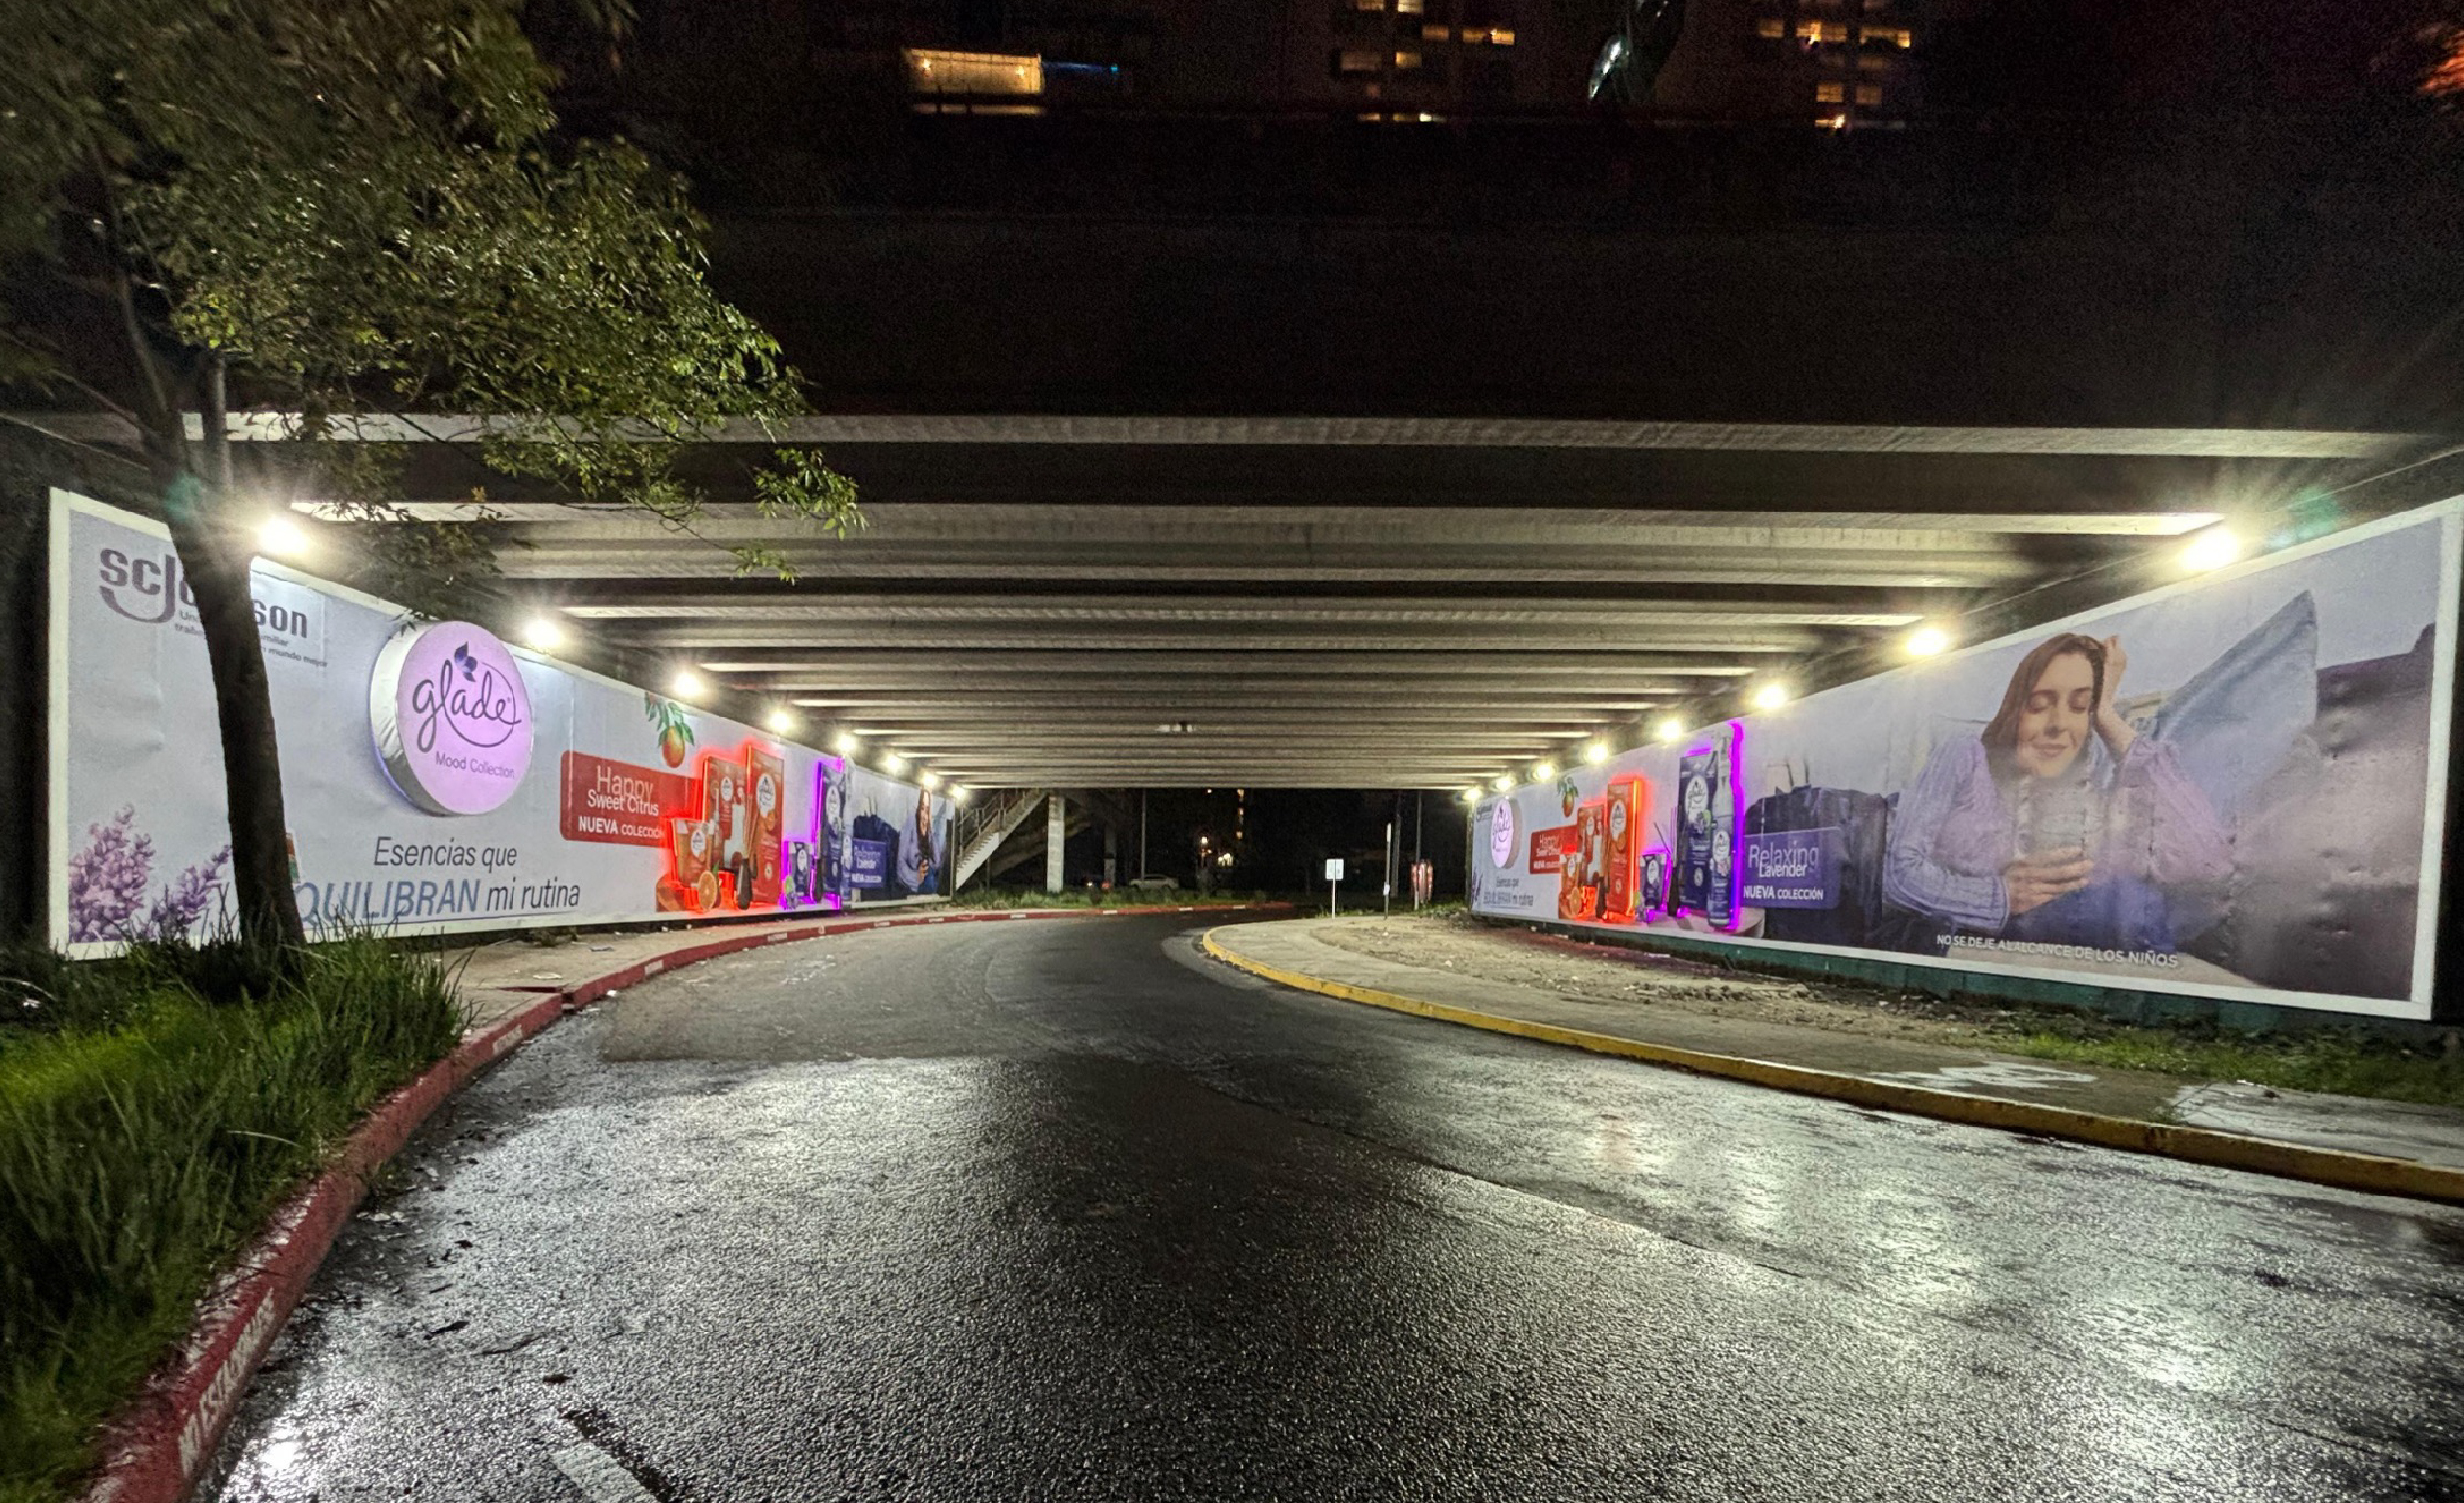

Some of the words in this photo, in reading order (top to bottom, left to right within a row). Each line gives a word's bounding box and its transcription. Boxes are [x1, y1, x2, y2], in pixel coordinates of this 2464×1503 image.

[412, 659, 522, 753] glade
[436, 751, 466, 770] Mood
[470, 758, 515, 779] Collection
[597, 765, 654, 802] Happy
[588, 789, 626, 811] Sweet
[627, 796, 659, 817] Citrus
[578, 816, 619, 835] NUEVA
[374, 836, 475, 867] Esencias
[481, 845, 517, 874] que
[1748, 840, 1820, 875] Relaxing
[1759, 860, 1808, 878] Lavender
[295, 878, 481, 925] QUILIBRAN
[487, 877, 515, 912] mi
[521, 877, 580, 912] rutina
[1743, 885, 1775, 900] NUEVA
[1777, 886, 1824, 901] COLECCIÓN
[1937, 934, 1951, 946] NO
[1953, 936, 1966, 947] SE
[1968, 937, 1994, 950] DEJE
[2075, 946, 2093, 960] DE
[2096, 949, 2124, 963] LOS
[2128, 950, 2179, 969] NIÑOS
